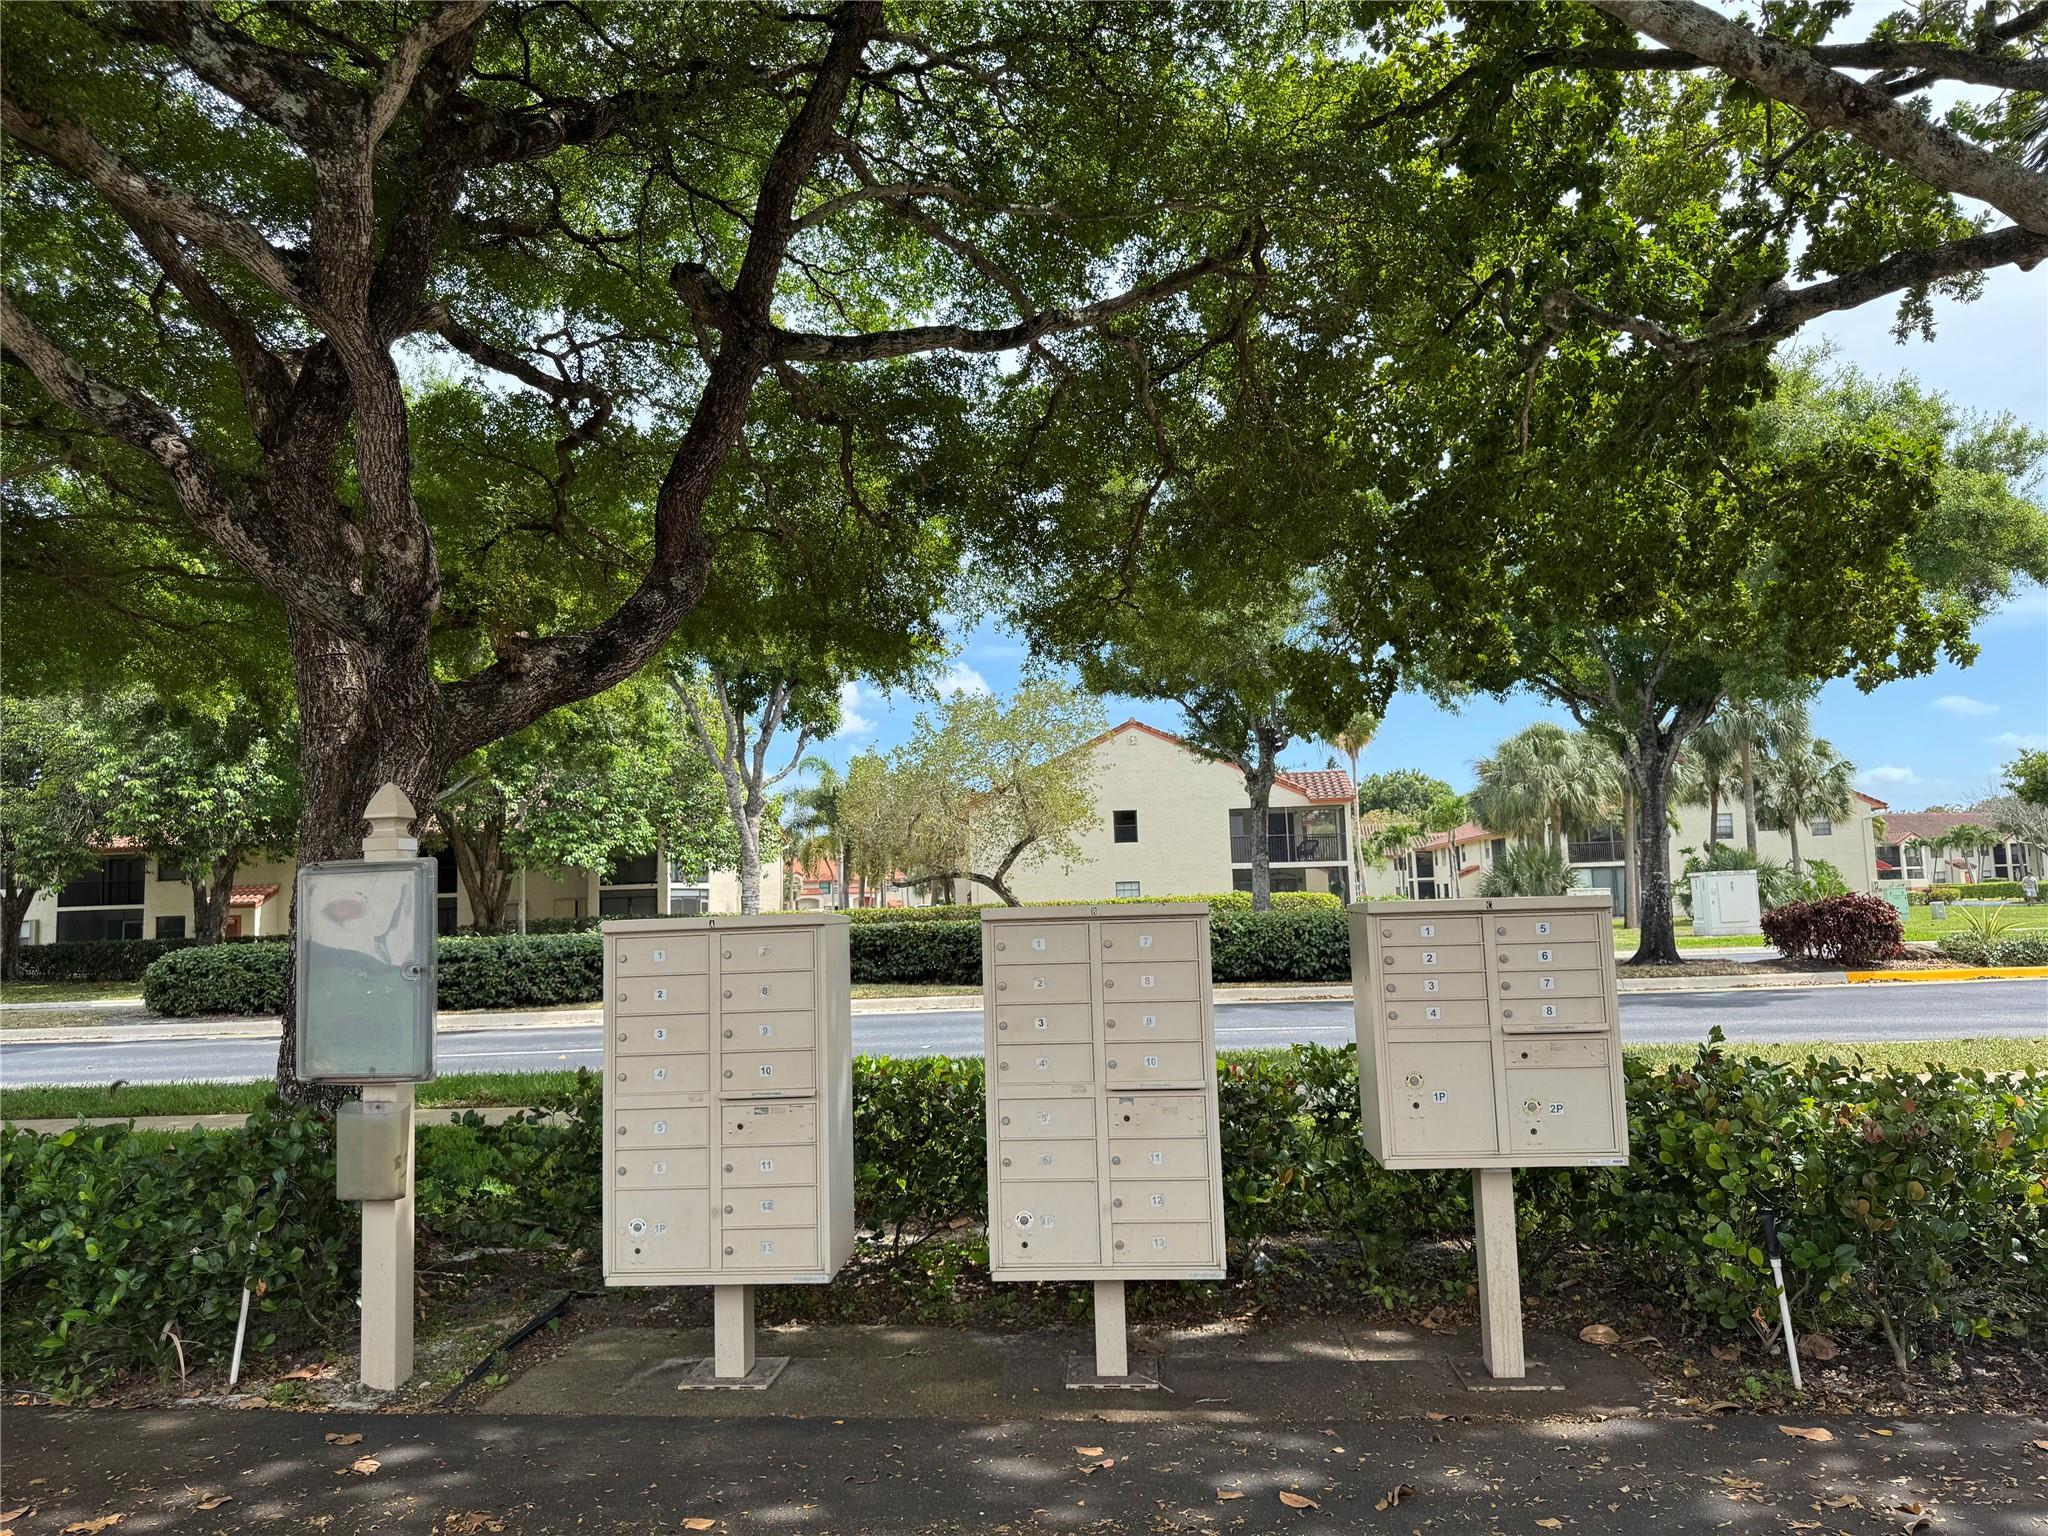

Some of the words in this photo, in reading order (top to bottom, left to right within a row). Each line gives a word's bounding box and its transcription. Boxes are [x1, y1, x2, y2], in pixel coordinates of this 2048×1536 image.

[1424, 927, 1431, 936] 1
[1539, 924, 1547, 934] 5
[1143, 937, 1150, 946] 7
[656, 950, 663, 960] 1
[1425, 953, 1433, 964] 2
[1541, 951, 1549, 961] 6
[1036, 977, 1044, 988] 2
[1144, 976, 1151, 986] 8
[1427, 981, 1435, 991] 3
[1543, 978, 1551, 988] 7
[656, 990, 664, 999] 2
[761, 986, 769, 996] 8
[1429, 1008, 1437, 1018] 4
[1545, 1006, 1553, 1016] 8
[1037, 1018, 1045, 1028] 3
[1146, 1016, 1153, 1026] 9
[656, 1029, 664, 1039] 3
[762, 1026, 769, 1036] 9
[1145, 1057, 1157, 1066] 10
[656, 1069, 664, 1079] 4
[759, 1066, 772, 1075] 10
[1432, 1092, 1446, 1101] 1P
[1549, 1105, 1564, 1113] 2P
[656, 1123, 664, 1133] 5
[1151, 1196, 1163, 1205] 12
[654, 1224, 667, 1232] 1P
